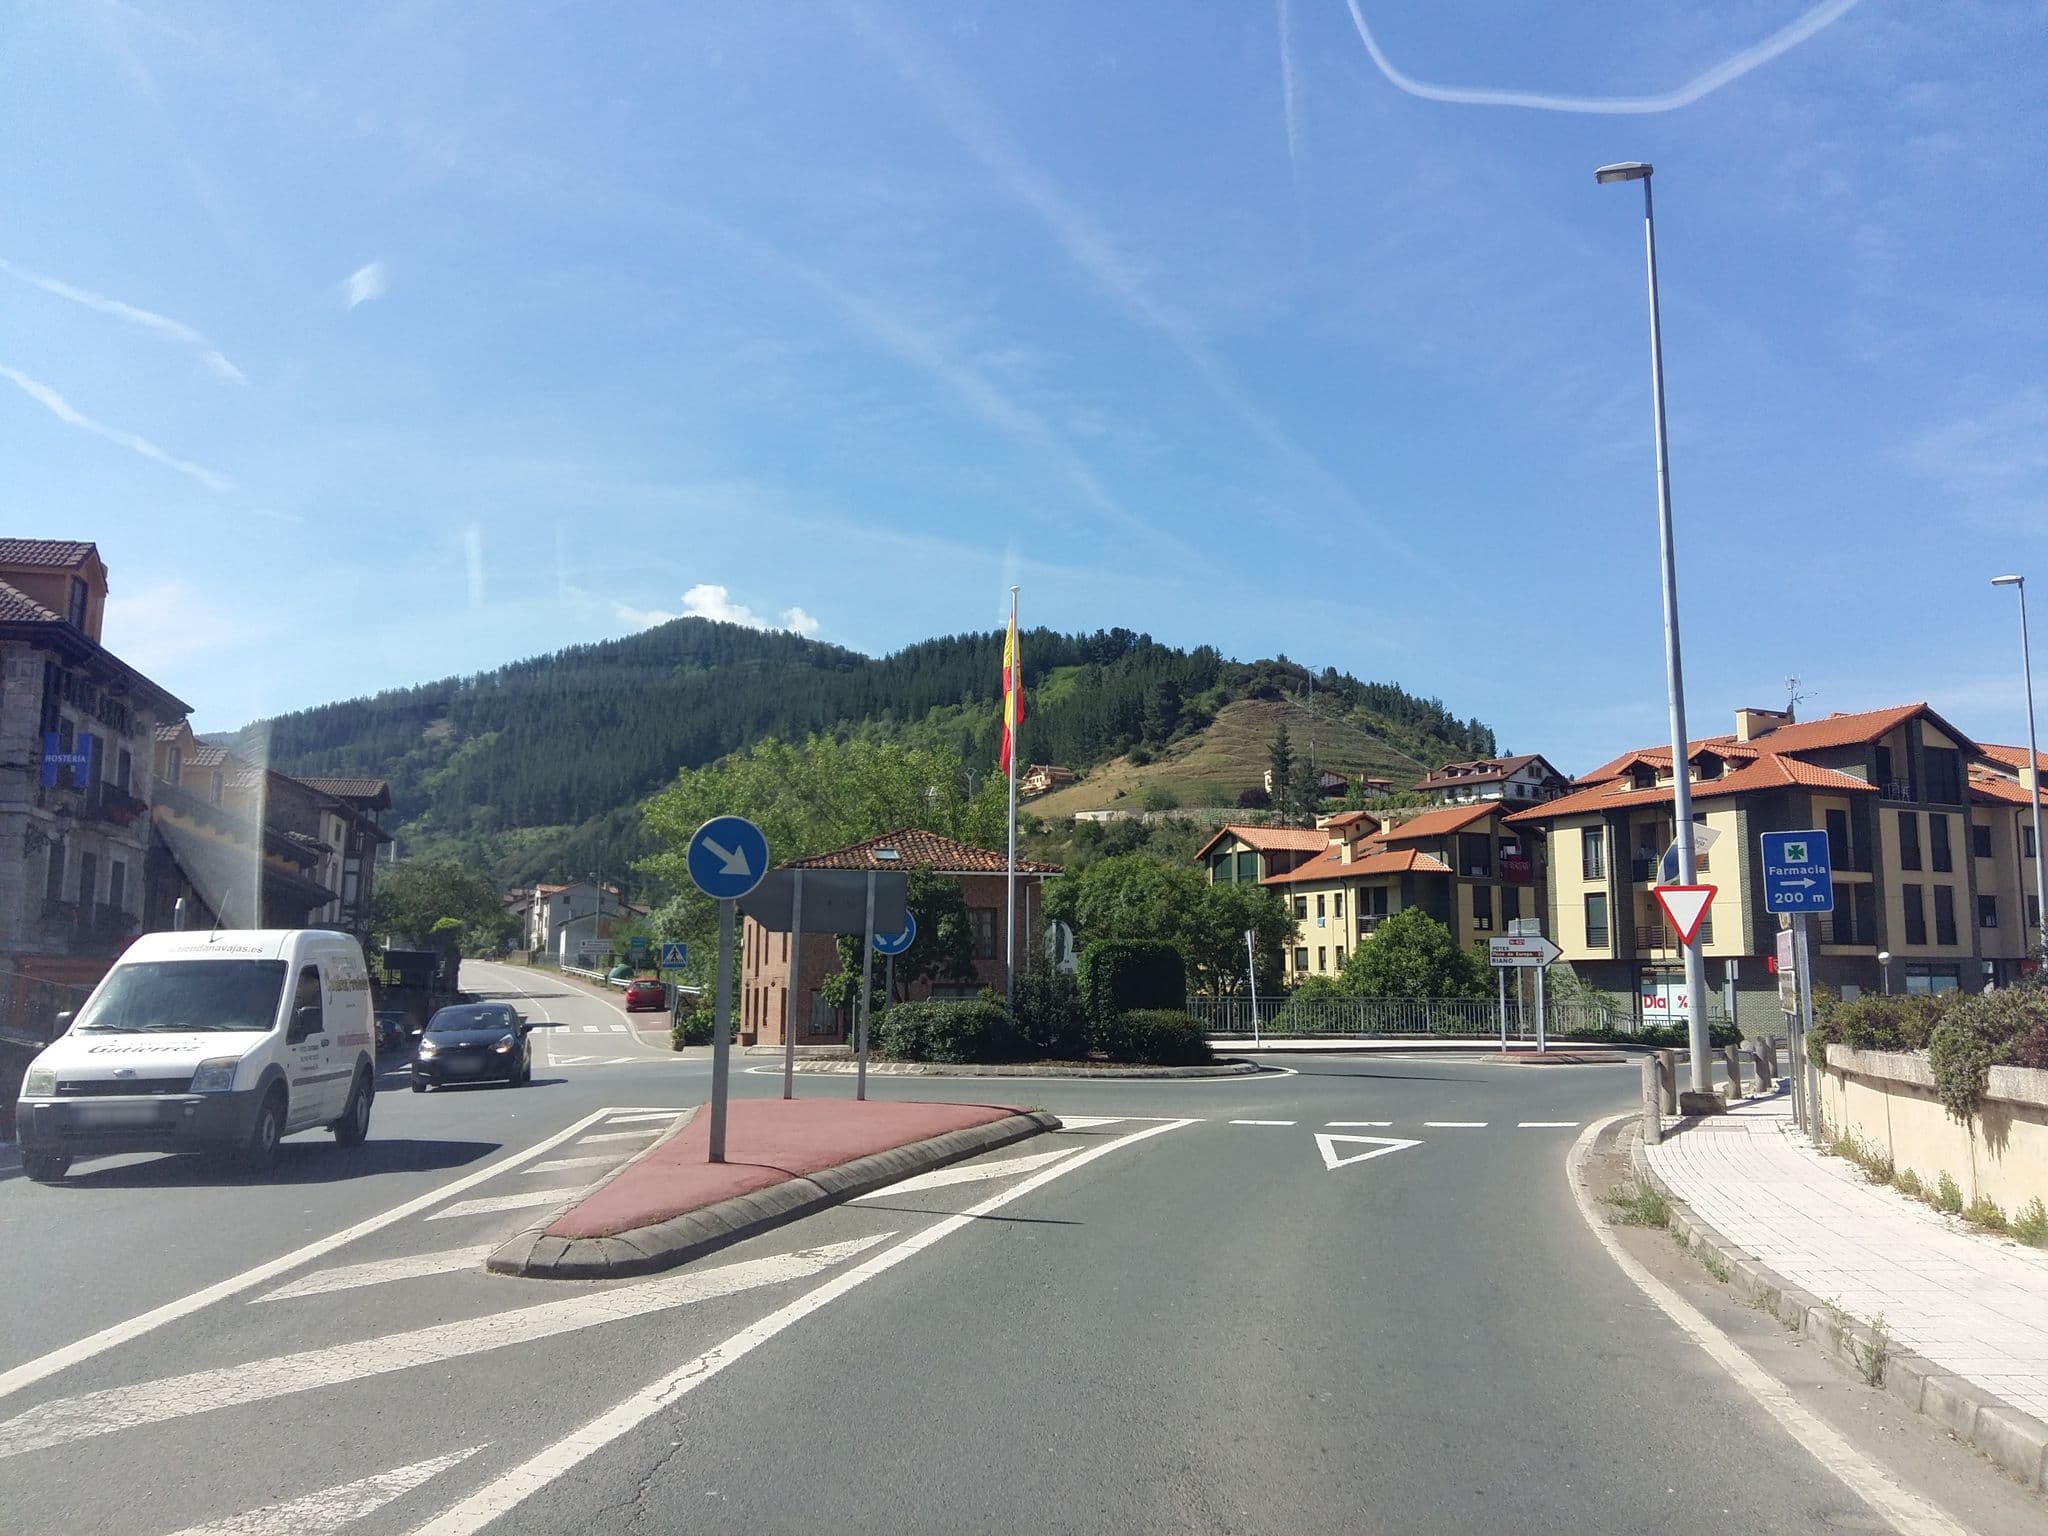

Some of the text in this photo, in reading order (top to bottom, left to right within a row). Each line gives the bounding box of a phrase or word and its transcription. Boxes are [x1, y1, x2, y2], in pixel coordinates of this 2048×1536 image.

[1769, 865, 1826, 876] Farmacia
[1774, 893, 1825, 903] 200 m
[1643, 994, 1666, 1009] Dia
